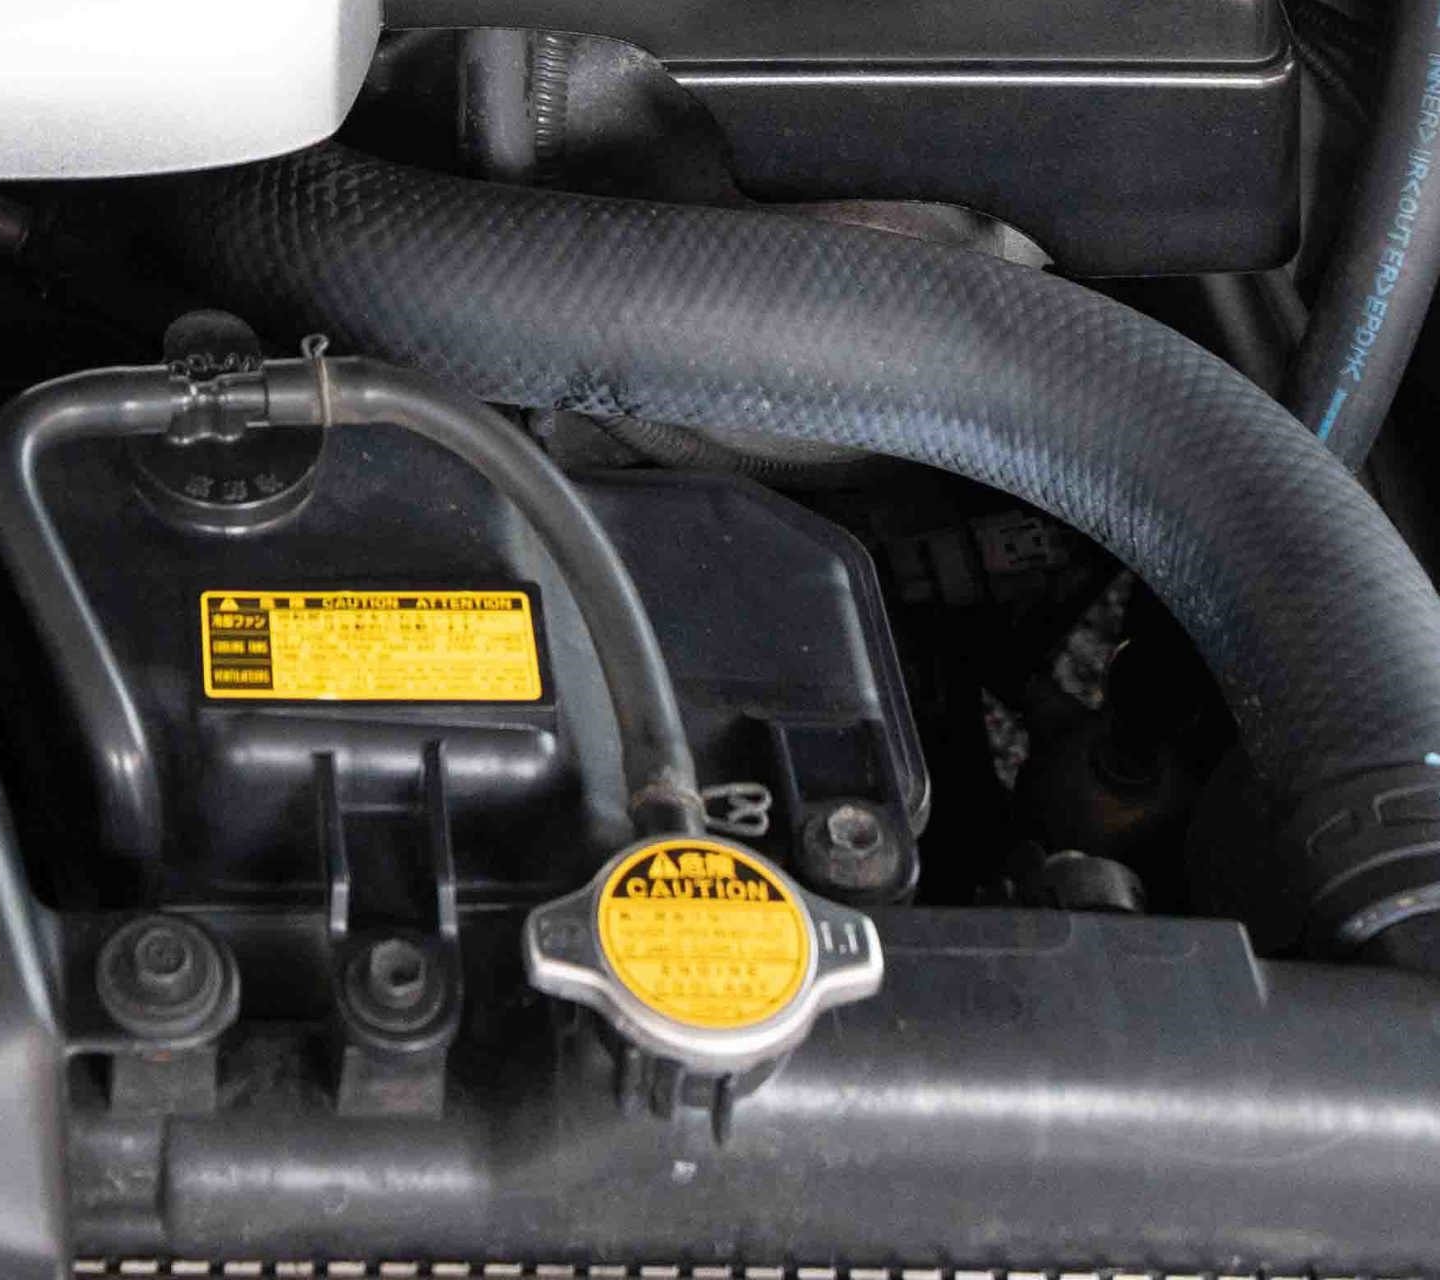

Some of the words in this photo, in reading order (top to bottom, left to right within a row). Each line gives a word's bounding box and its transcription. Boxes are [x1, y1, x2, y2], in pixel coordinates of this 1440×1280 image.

[322, 597, 399, 610] CAUTION
[416, 597, 512, 610] ATTENTION
[626, 878, 770, 901] CAUTION
